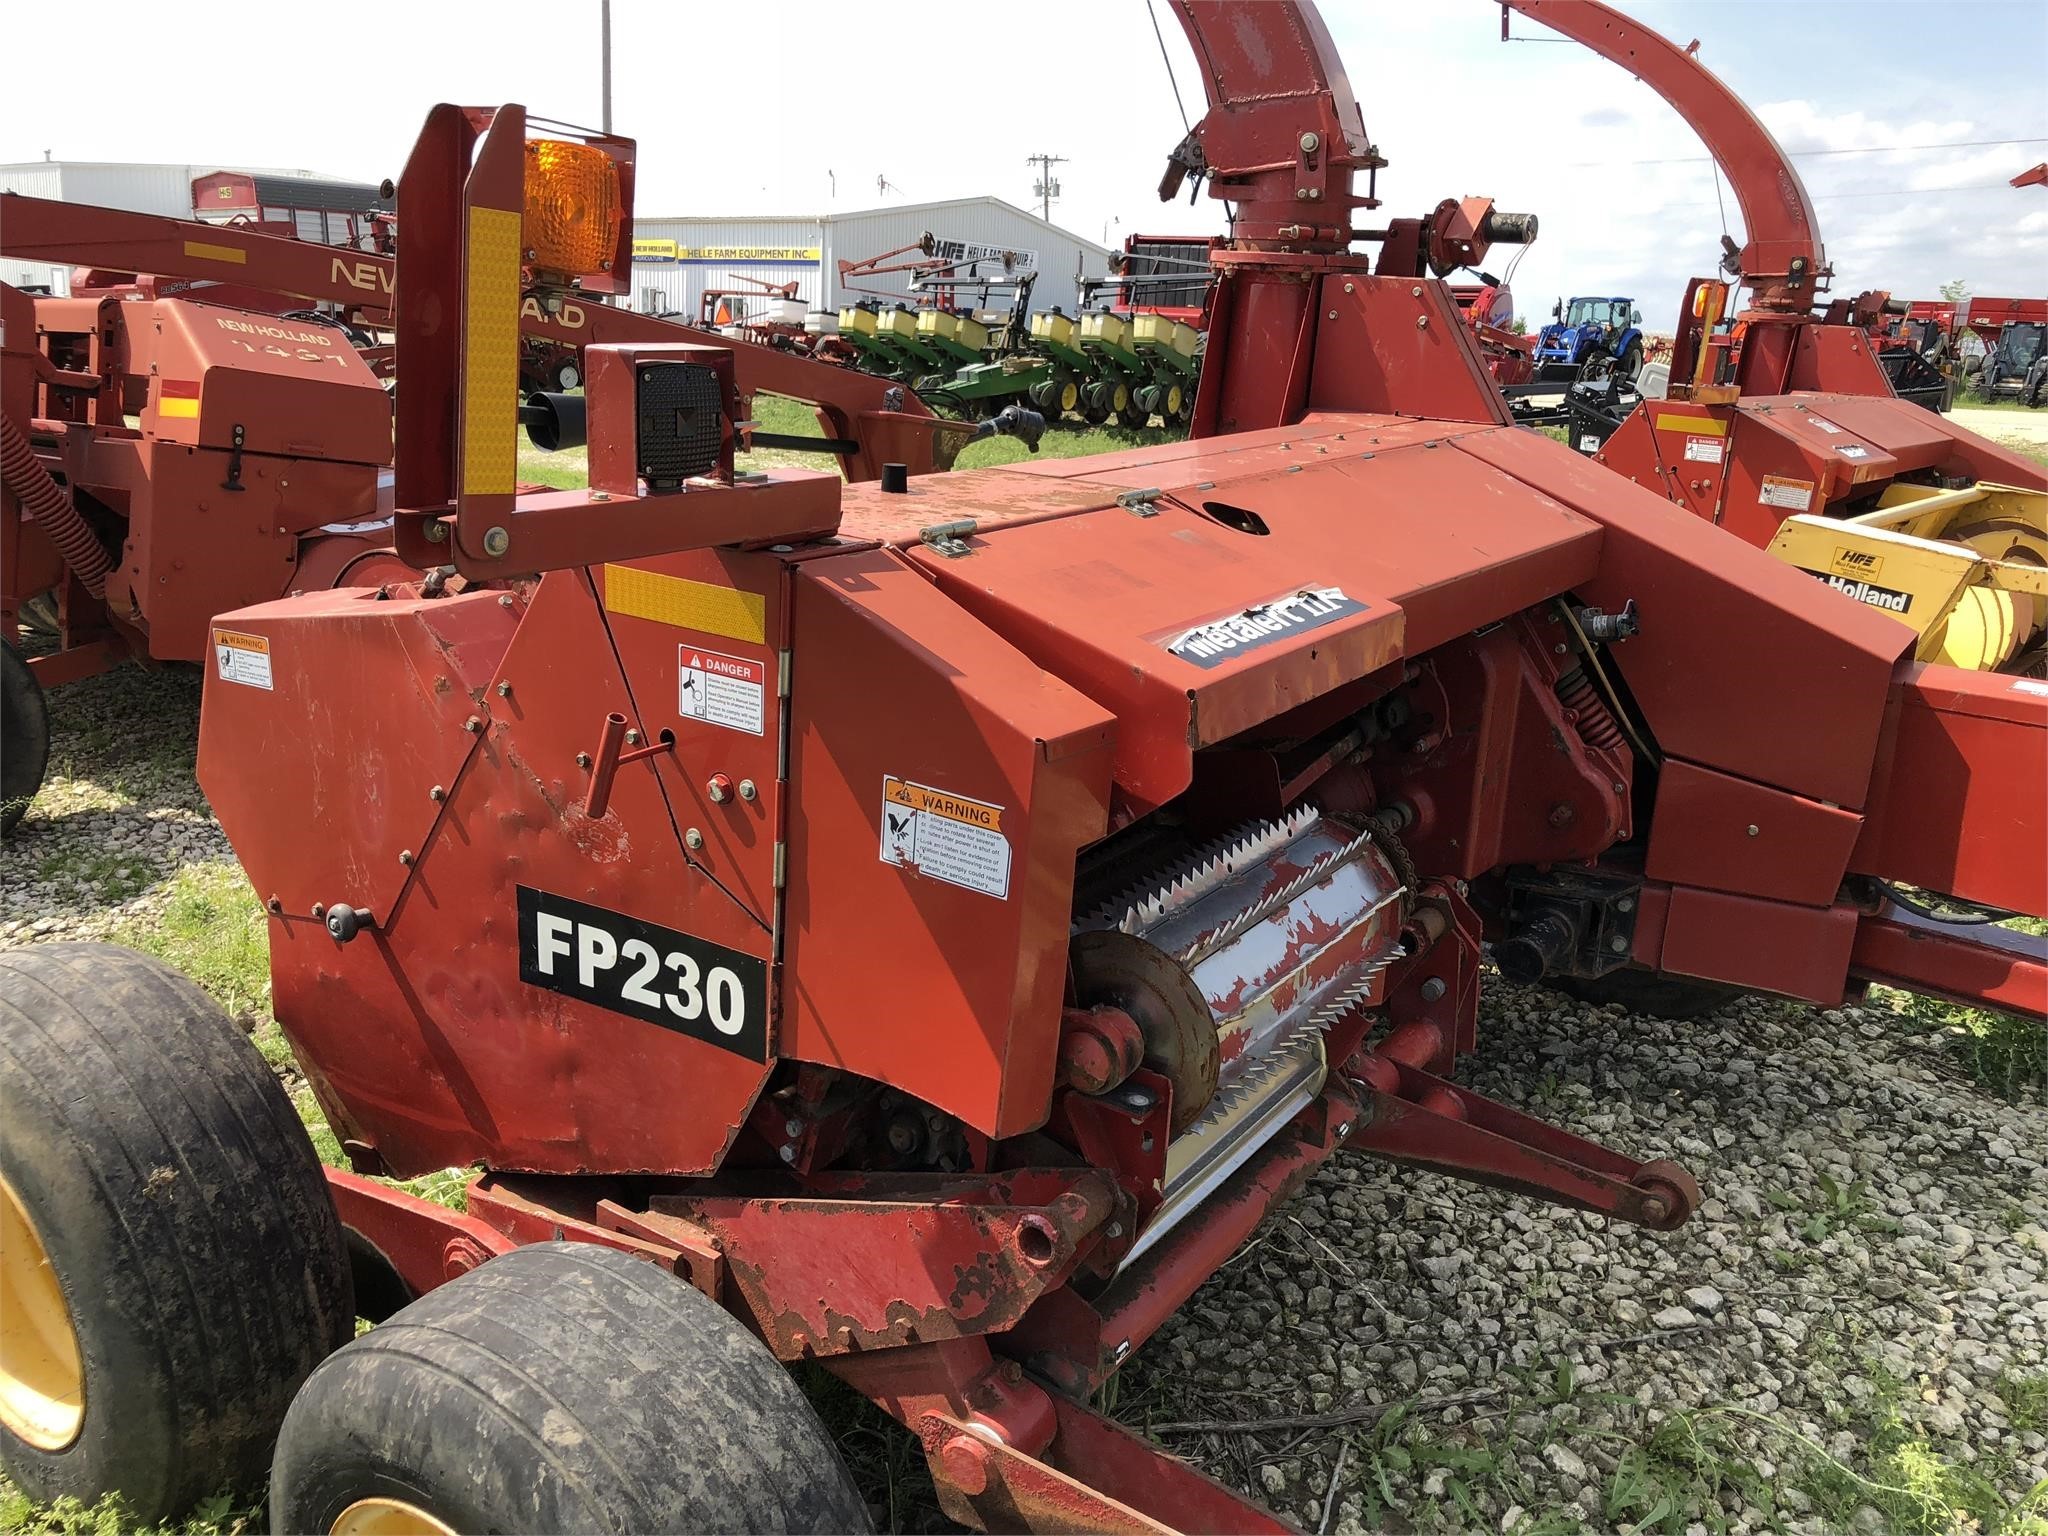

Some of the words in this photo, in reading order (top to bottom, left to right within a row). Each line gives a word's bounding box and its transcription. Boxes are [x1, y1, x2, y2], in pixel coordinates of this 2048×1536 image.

[688, 249, 712, 258] HELLE
[715, 249, 736, 258] FARM
[739, 249, 790, 259] EQUIPMENT
[216, 318, 254, 334] NEW
[255, 326, 331, 346] HOLLAND
[1828, 575, 1908, 611] Holland
[229, 635, 262, 649] WARNING
[706, 658, 750, 678] DANGER
[922, 793, 990, 825] WARNING
[944, 819, 958, 829] parts
[959, 824, 974, 833] under
[975, 828, 985, 836] this
[986, 832, 1001, 841] cover
[950, 829, 966, 838] rotate
[976, 836, 995, 847] several
[942, 834, 954, 842] after
[954, 838, 970, 848] power
[978, 844, 990, 853] shut
[940, 850, 956, 860] before
[957, 856, 981, 869] removing
[968, 851, 992, 864] evidence
[919, 853, 938, 864] Failure
[946, 861, 966, 874] comply
[968, 868, 984, 879] could
[986, 874, 1002, 884] result
[925, 863, 940, 873] death
[949, 871, 970, 883] serious
[537, 911, 745, 1036] FP230
